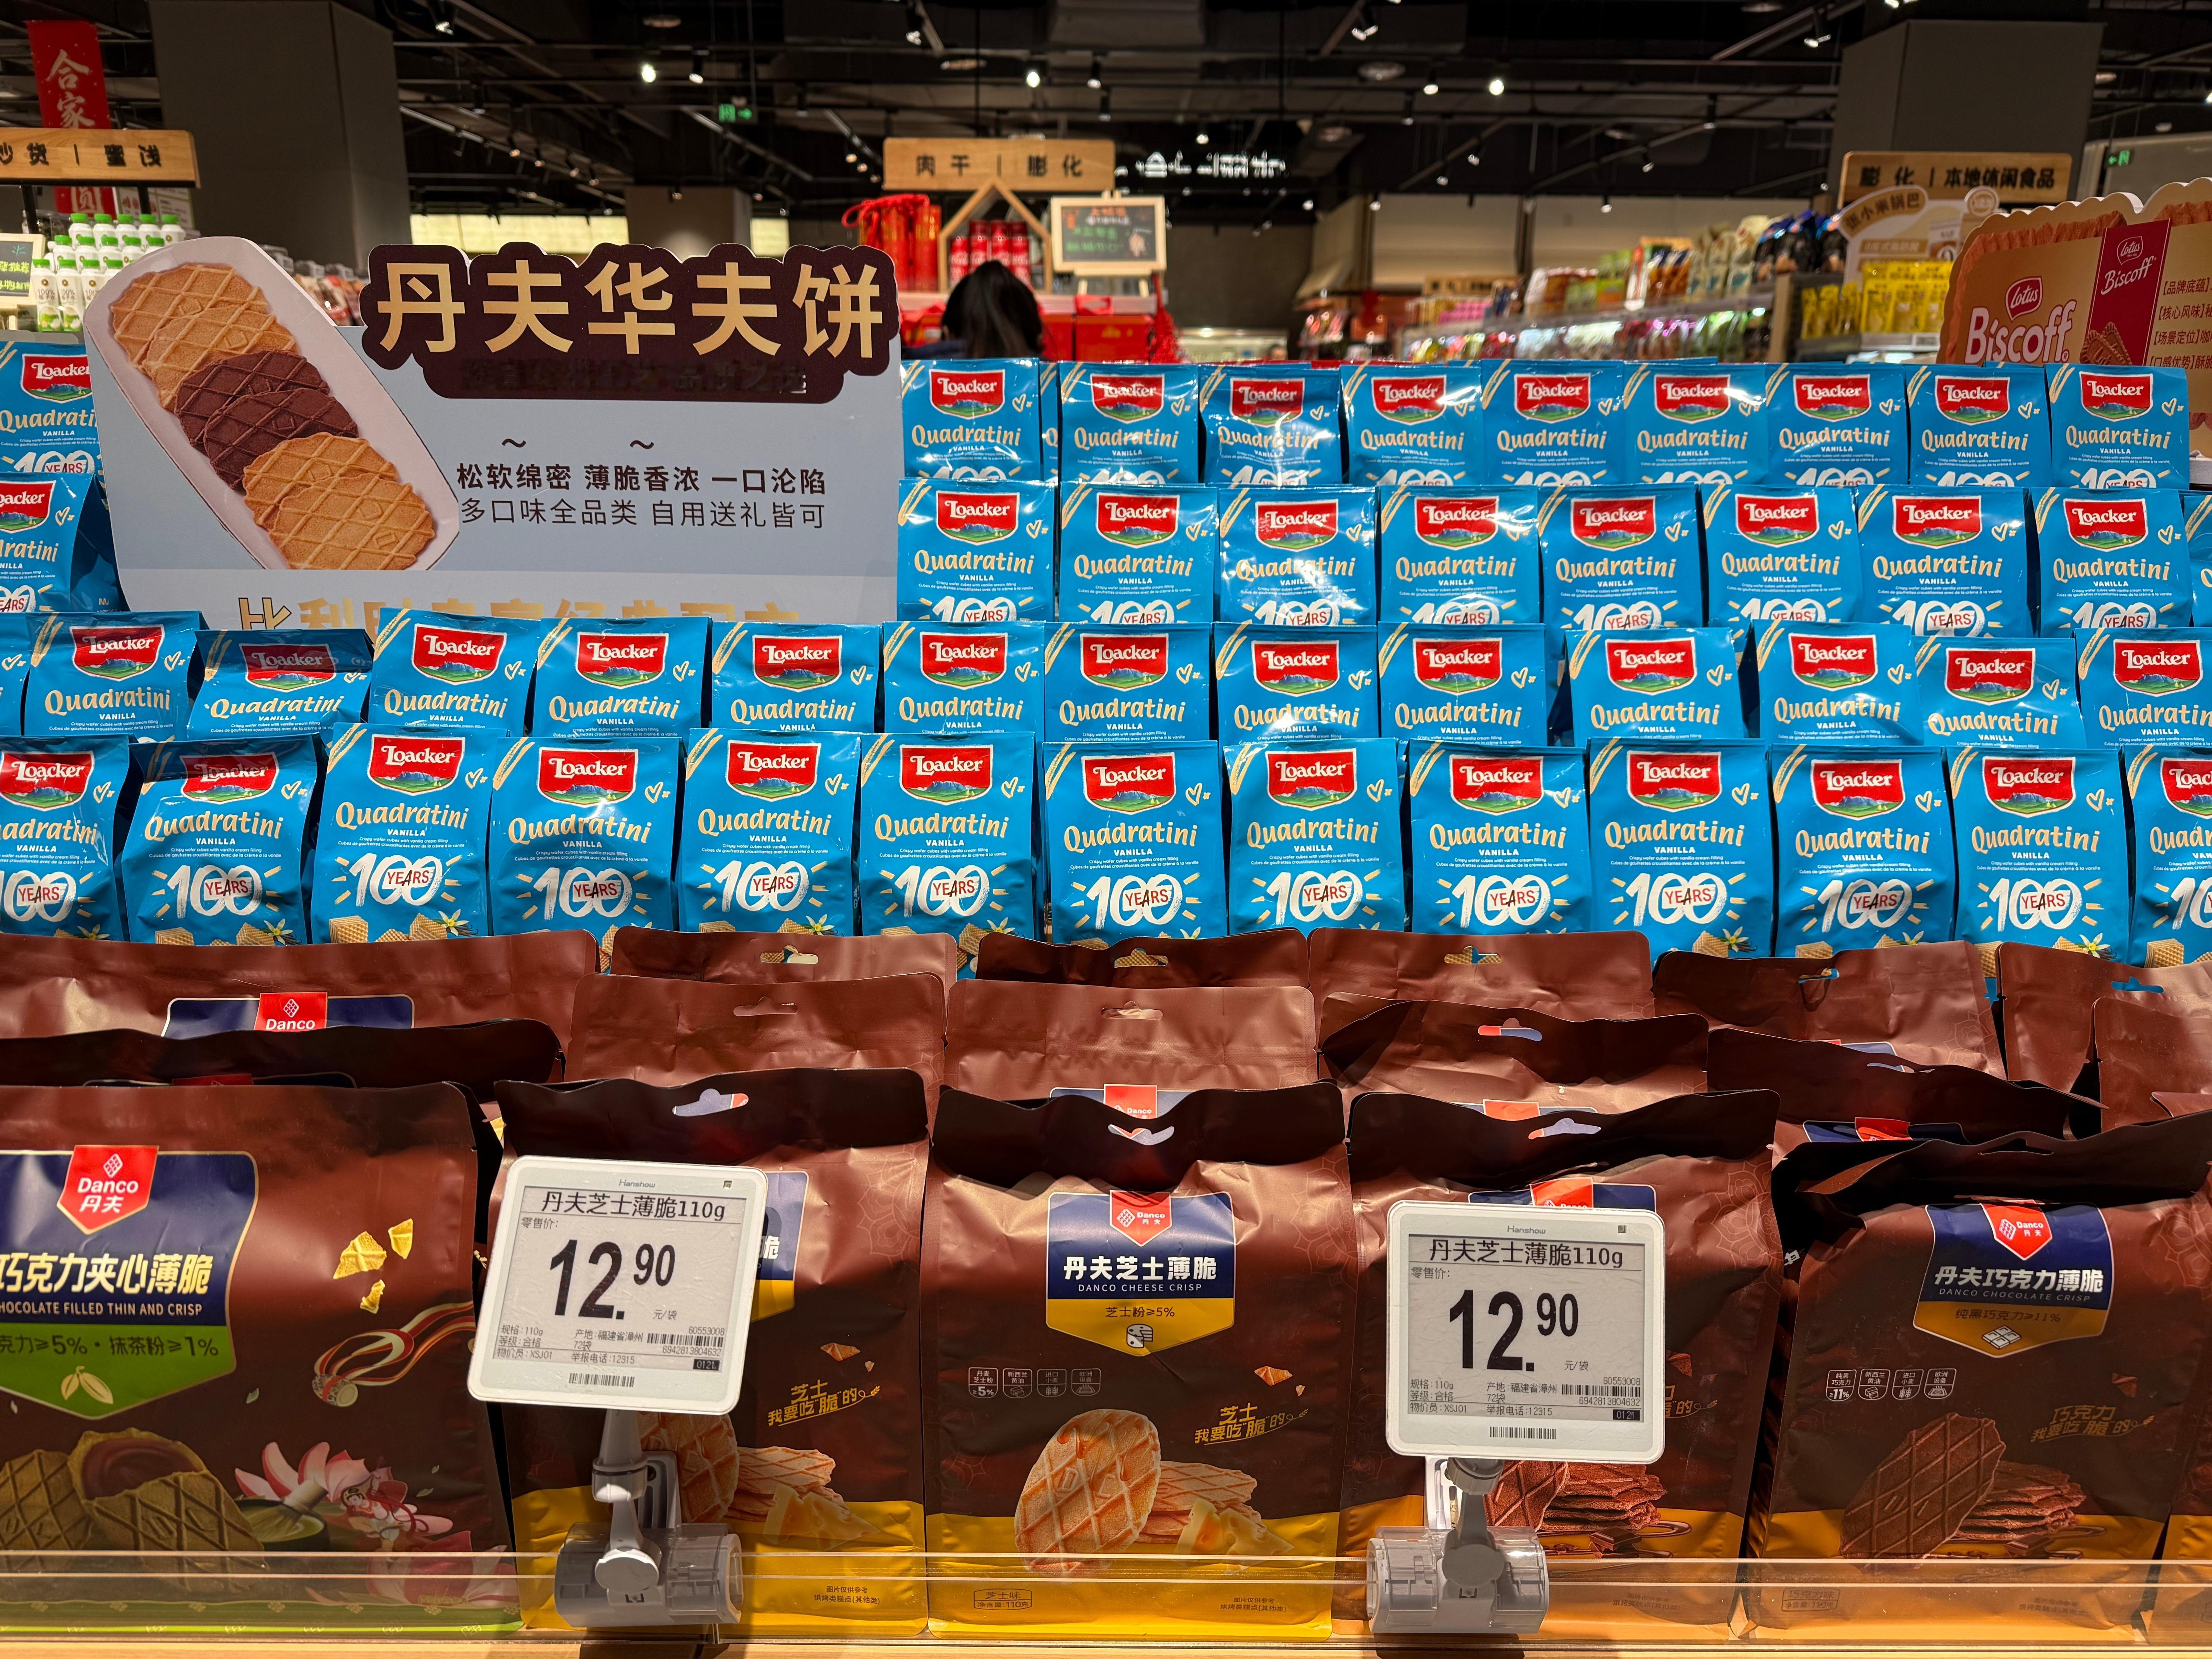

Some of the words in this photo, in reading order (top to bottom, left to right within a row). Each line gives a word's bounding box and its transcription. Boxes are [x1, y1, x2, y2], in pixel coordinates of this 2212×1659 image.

[917, 155, 970, 176] 肉干
[1027, 155, 1083, 177] 膨化
[1860, 166, 1913, 187] 膨化
[1944, 166, 2055, 189] 本地休闲食品
[2120, 241, 2140, 257] Lotus
[2101, 255, 2154, 295] Biscoff
[2163, 277, 2212, 295] 【品牌底蕴】
[2010, 286, 2039, 309] Lotus
[377, 259, 883, 359] 丹夫华夫饼
[2154, 329, 2212, 345] 【场景定位】咖
[1802, 385, 1862, 400] Loacker
[2087, 381, 2144, 397] Loacker
[2067, 426, 2169, 448] Quadratini
[456, 463, 570, 491] 松软绵密
[584, 464, 701, 493] 薄脆香浓
[711, 467, 826, 495] 一口沦陷
[461, 497, 638, 526] 多口味全品类
[652, 501, 825, 529] 自用送礼皆可
[1580, 508, 1647, 525] Loacker
[2072, 508, 2136, 526] Loacker
[1874, 556, 2001, 580] Quadratini
[1933, 614, 1971, 626] YEARS
[86, 636, 155, 654] Loacker
[589, 642, 658, 662] Loacker
[1614, 649, 1685, 668] Loacker
[2121, 650, 2190, 669] Loacker
[1060, 699, 1184, 726] Quadratini
[381, 742, 455, 766] Loacker
[11, 761, 88, 783] Loacker
[910, 756, 983, 776] Loacker
[1991, 767, 2064, 787] Loacker
[509, 815, 649, 845] Quadratini
[1065, 823, 1196, 853] Quadratini
[1606, 821, 1743, 849] Quadratini
[388, 870, 429, 885] YEARS
[1084, 874, 1183, 929] 100
[266, 1018, 316, 1030] Danco
[78, 1178, 138, 1194] Danco
[619, 1179, 656, 1188] Hanshow
[79, 1196, 123, 1214] 丹夫
[541, 1191, 726, 1222] 丹夫芝士薄脆110g
[521, 1216, 558, 1230] 零售价:
[1137, 1211, 1165, 1219] Danco
[1507, 1225, 1546, 1235] Hanshow
[1429, 1240, 1623, 1268] 丹夫芝士薄脆110g
[0, 1253, 213, 1295] 巧克力夹心薄脆
[1063, 1255, 1217, 1281] 丹夫芝士薄脆
[1411, 1266, 1451, 1280] 零售价:
[1078, 1283, 1117, 1292] DANCO
[1121, 1283, 1165, 1292] CHEESE
[1170, 1283, 1202, 1291] CRISP
[1934, 1266, 2104, 1293] 丹夫巧克力薄脆
[1939, 1288, 1978, 1297] DANCO
[1983, 1290, 2052, 1301] CHOCOLATE
[2056, 1293, 2091, 1302] CRISP
[64, 1302, 103, 1315] FILLED
[107, 1303, 136, 1316] THIN
[140, 1303, 164, 1316] AND
[167, 1304, 203, 1316] CRISP
[653, 1309, 677, 1321] 元/袋
[1105, 1306, 1176, 1318] 芝士粉≥5%
[501, 1325, 543, 1336] 规格:110g
[574, 1329, 643, 1342] 产地:福建省漳州
[689, 1326, 725, 1336] 60553008
[498, 1336, 541, 1348] 等级:合格
[574, 1340, 592, 1351] 72袋
[571, 1352, 635, 1364] 举报电话:12315
[663, 1345, 721, 1356] 6942813804632
[1564, 1360, 1589, 1372] 元/袋
[1410, 1379, 1454, 1390] 规格:110g
[1487, 1382, 1557, 1394] 产地:福建省漳州
[1603, 1377, 1640, 1386] 60553008
[791, 1379, 828, 1404] 芝士
[973, 1386, 994, 1396] ≥5%
[1410, 1390, 1453, 1401] 等级:合格
[1487, 1393, 1505, 1403] 72袋
[1410, 1402, 1467, 1413] 物价员:XSJ01
[1579, 1396, 1640, 1407] 6942813804632
[1219, 1402, 1258, 1425] 芝士
[1487, 1405, 1553, 1416] 举报电话:12315
[1617, 1411, 1634, 1419] 0121
[2050, 1404, 2116, 1425] 巧克力
[985, 1591, 1021, 1600] 芝士味
[977, 1601, 1029, 1609] 净含量:110克
